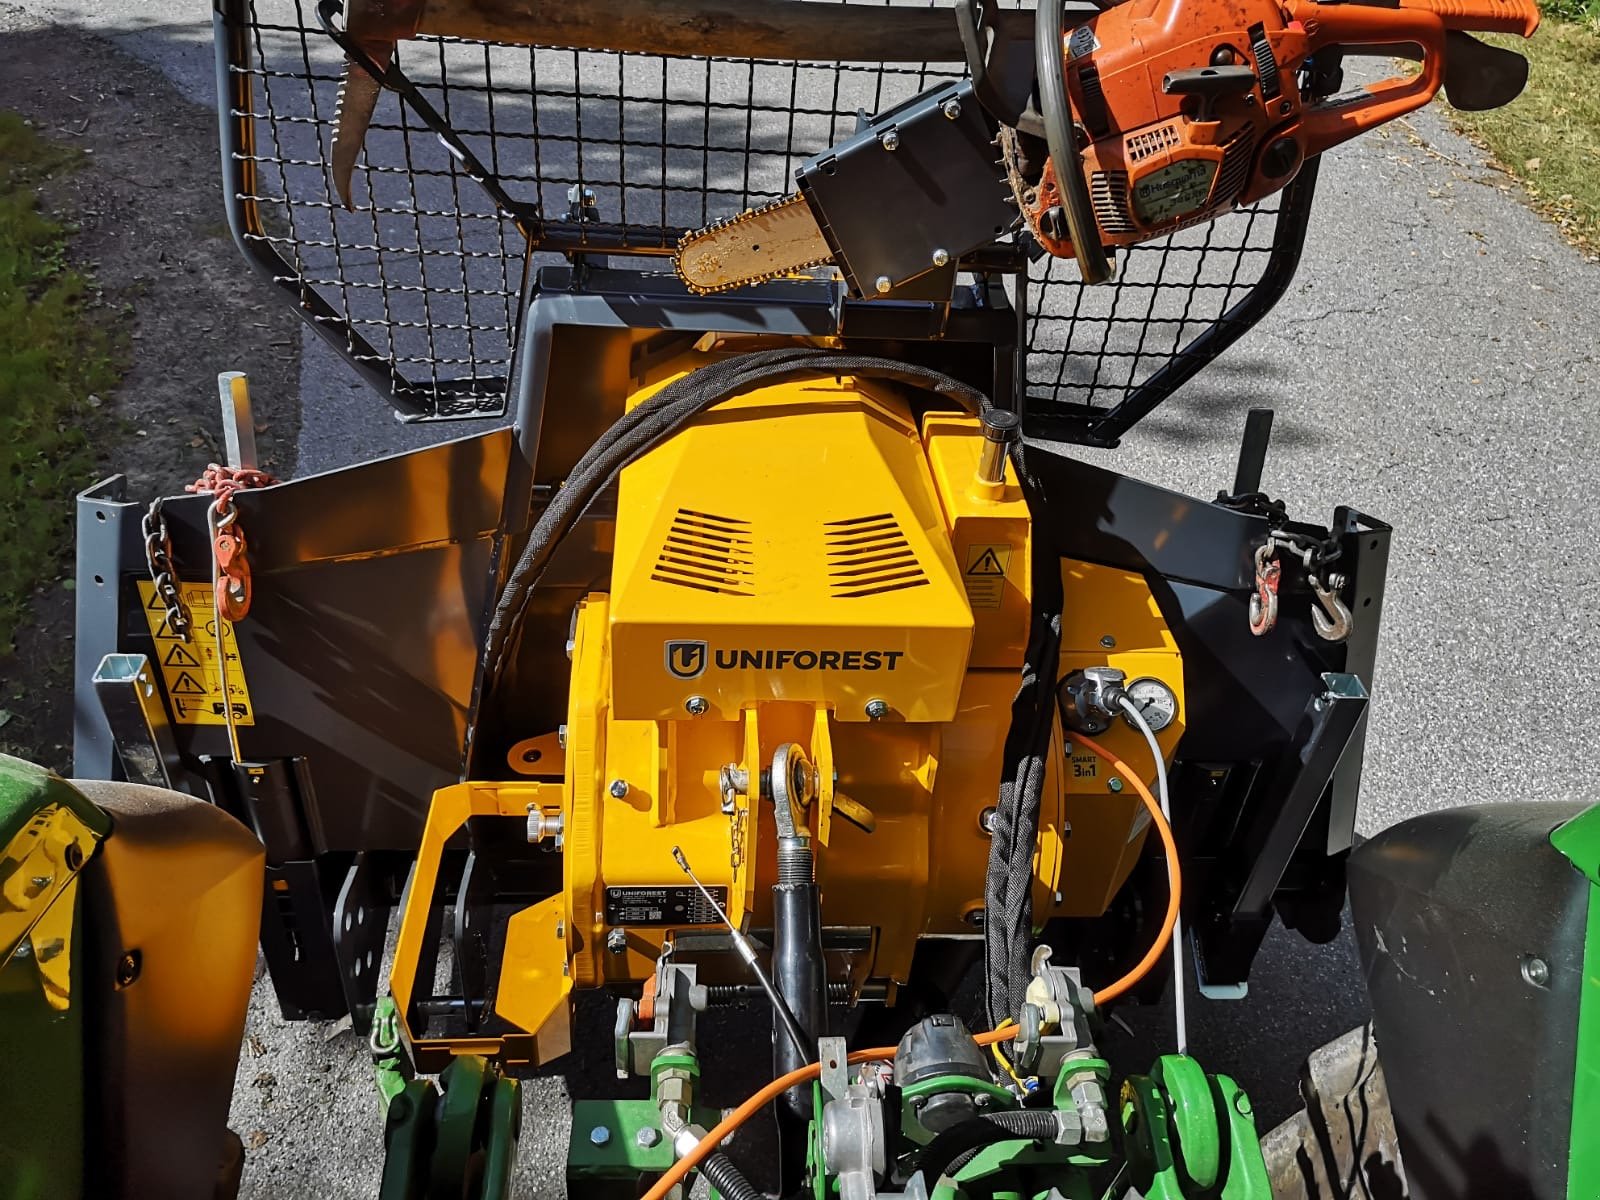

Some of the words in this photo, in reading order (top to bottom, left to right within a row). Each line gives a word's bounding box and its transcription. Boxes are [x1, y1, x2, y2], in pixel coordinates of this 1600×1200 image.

[716, 650, 904, 671] UNIFOREST
[1072, 755, 1097, 764] SMART
[1073, 764, 1097, 777] 3in1
